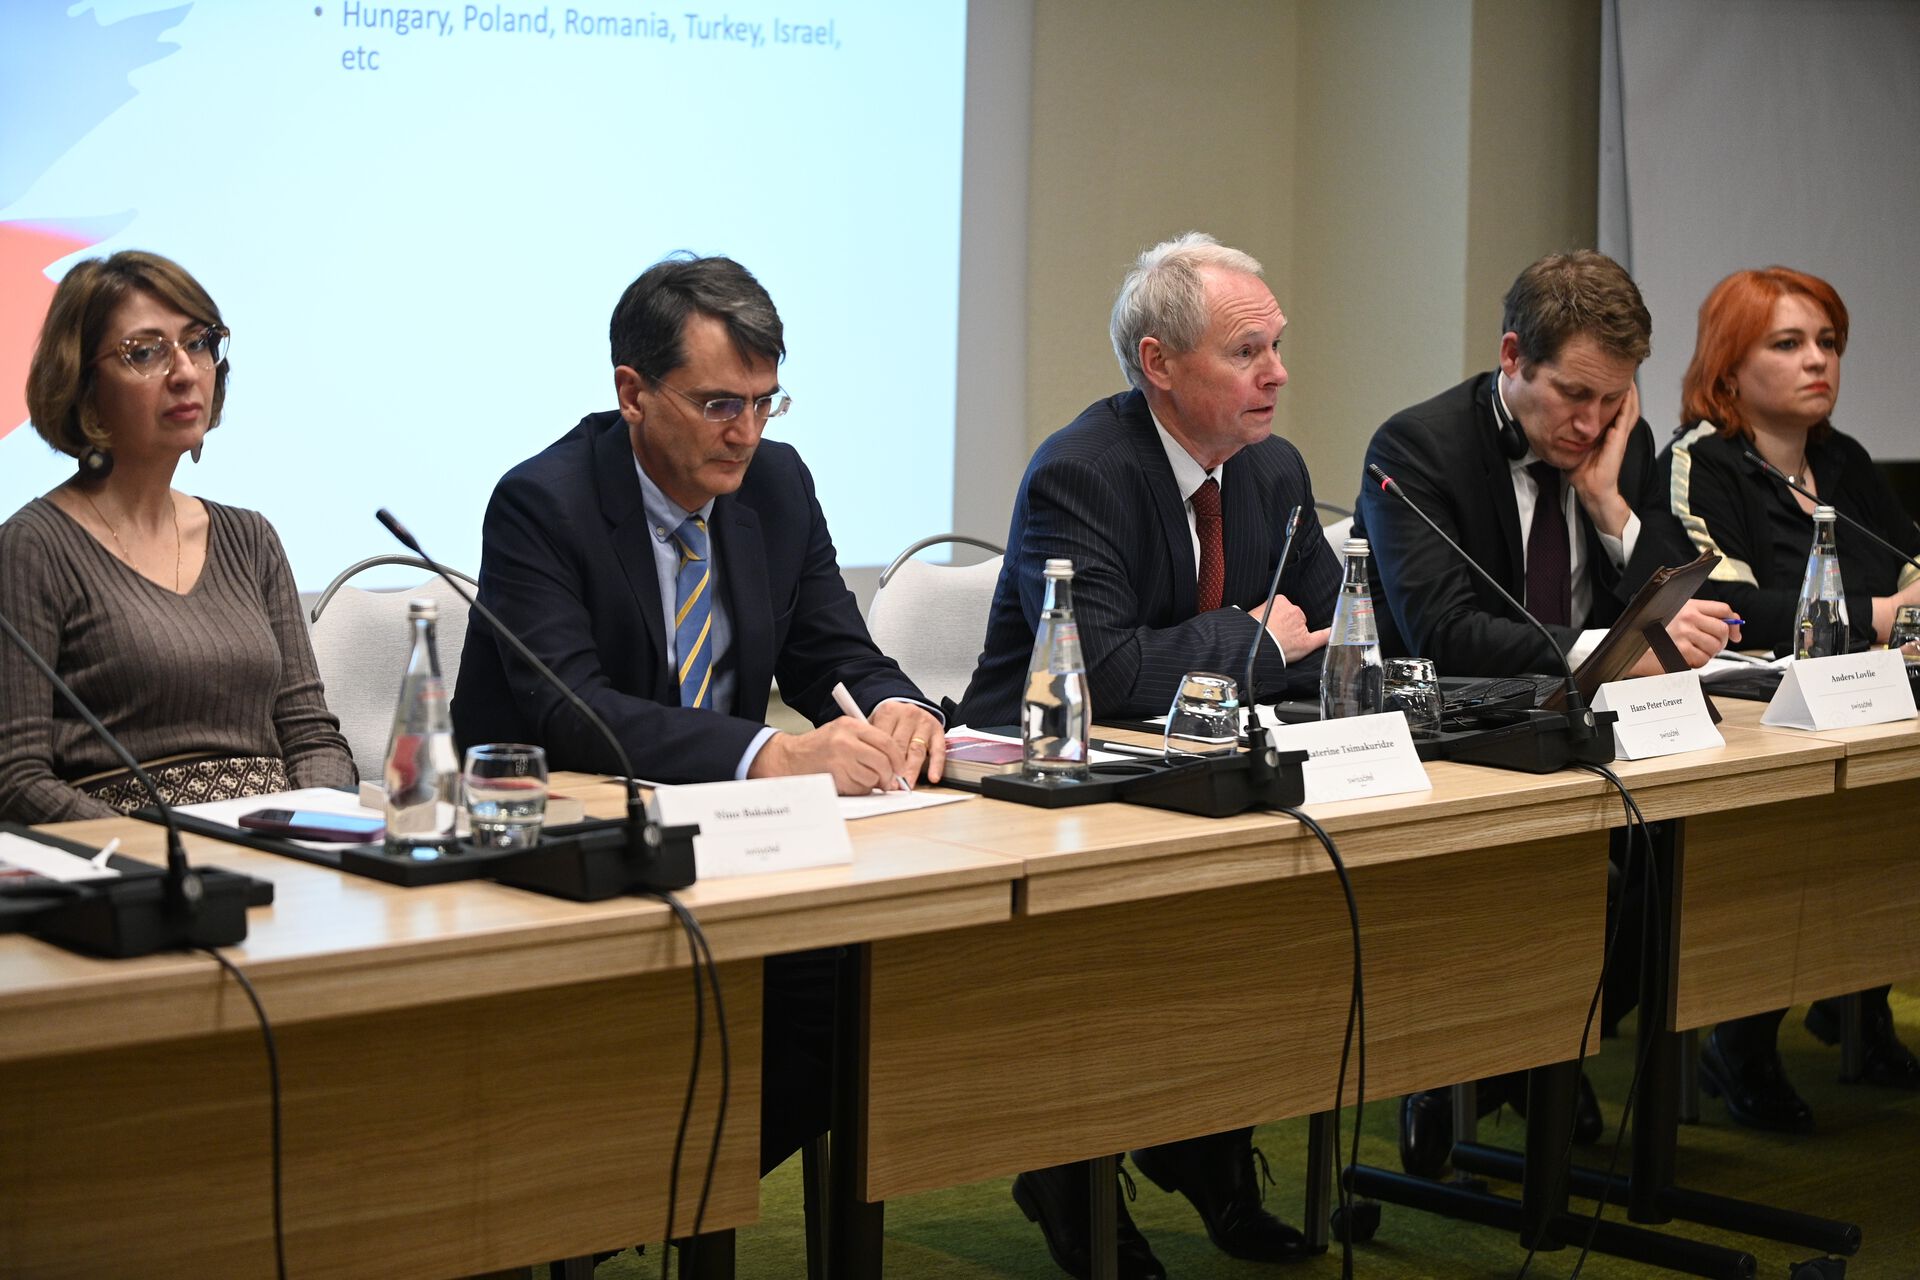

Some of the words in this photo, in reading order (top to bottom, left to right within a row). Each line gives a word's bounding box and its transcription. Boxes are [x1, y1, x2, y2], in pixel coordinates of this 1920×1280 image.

[342, 0, 454, 36] Hungary,
[464, 4, 556, 39] Poland,
[564, 8, 677, 43] Romania,
[684, 13, 766, 47] Turkey,
[774, 18, 842, 50] Israel,
[341, 46, 380, 71] etc
[1831, 673, 1855, 683] Anders
[1630, 704, 1647, 713] Hans
[1646, 702, 1662, 710] Peter
[1662, 698, 1683, 707] Graver
[1341, 740, 1395, 754] Tsimakuridze
